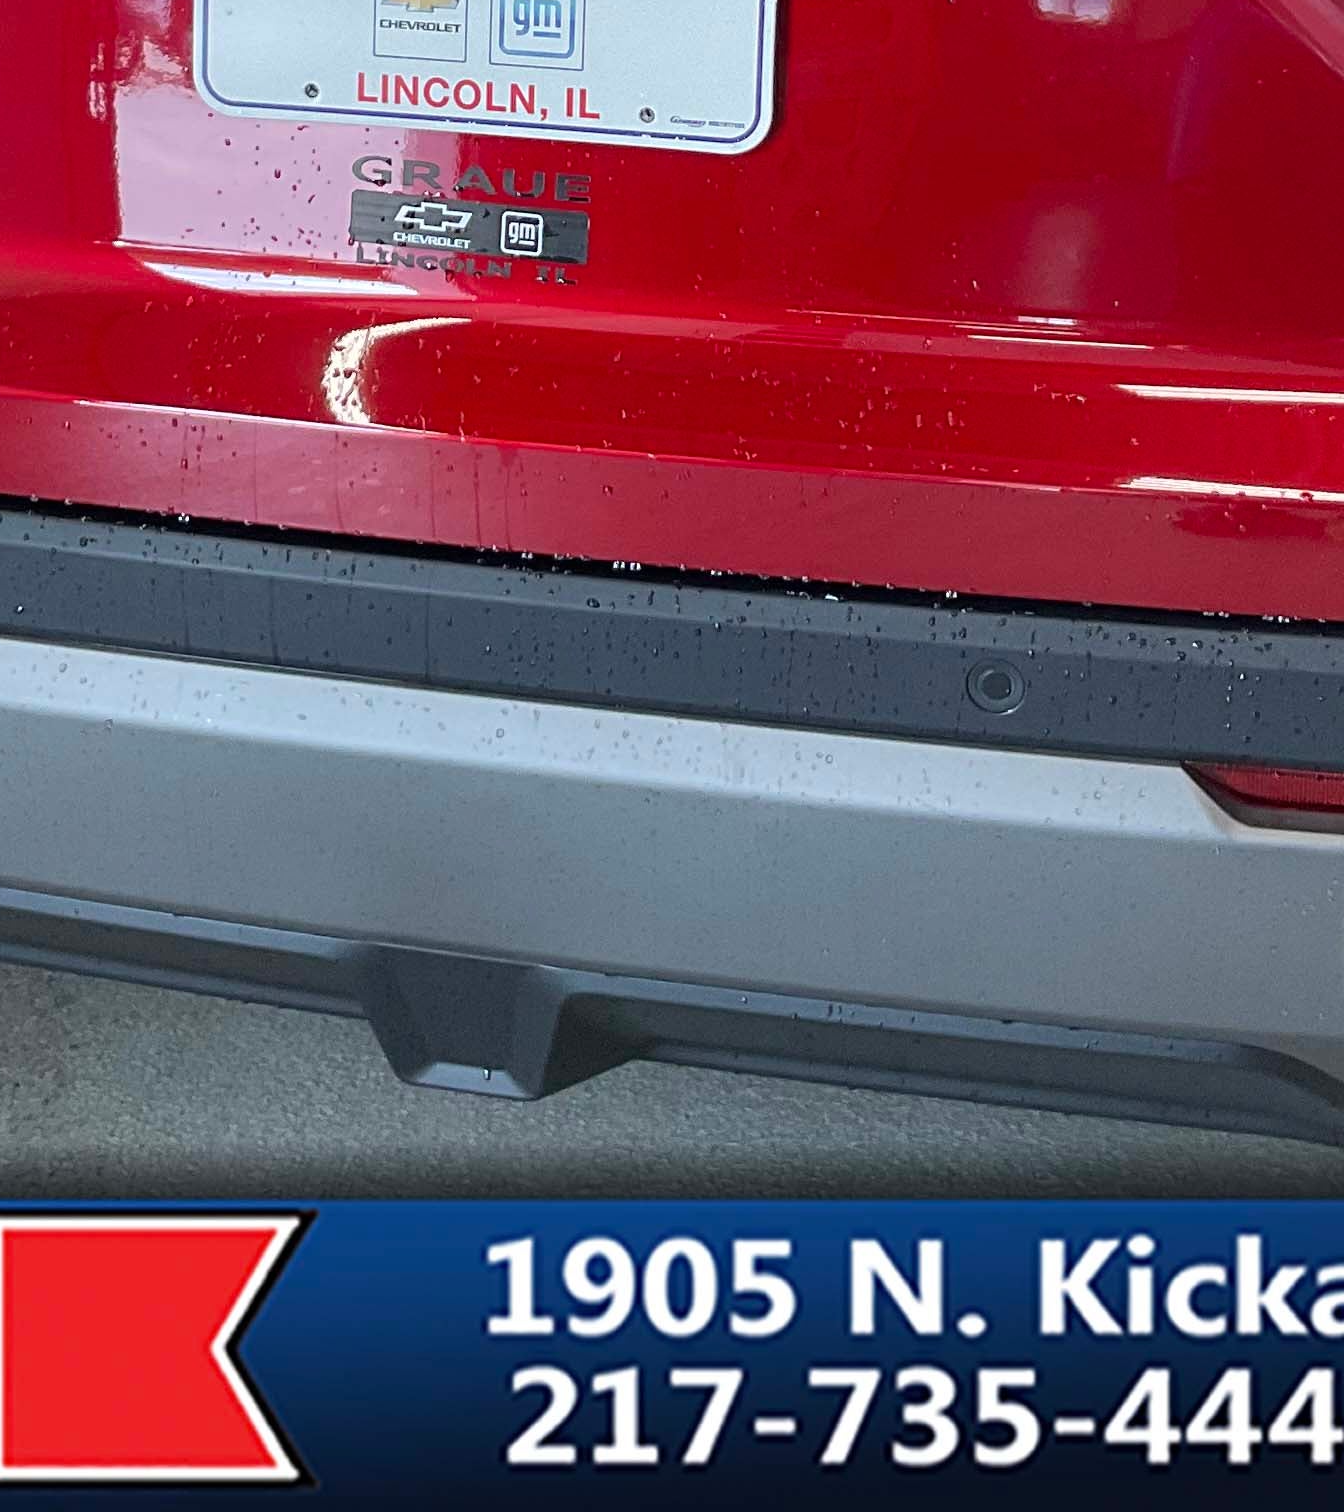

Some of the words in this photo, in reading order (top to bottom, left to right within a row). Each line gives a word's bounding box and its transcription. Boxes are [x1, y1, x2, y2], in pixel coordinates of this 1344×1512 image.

[379, 18, 462, 33] CHEVROLET
[357, 72, 548, 121] LINCOLN,
[566, 87, 600, 119] IL
[352, 156, 590, 203] GRAUE
[393, 232, 471, 249] CHEVROLET
[356, 243, 512, 279] LINCOLN
